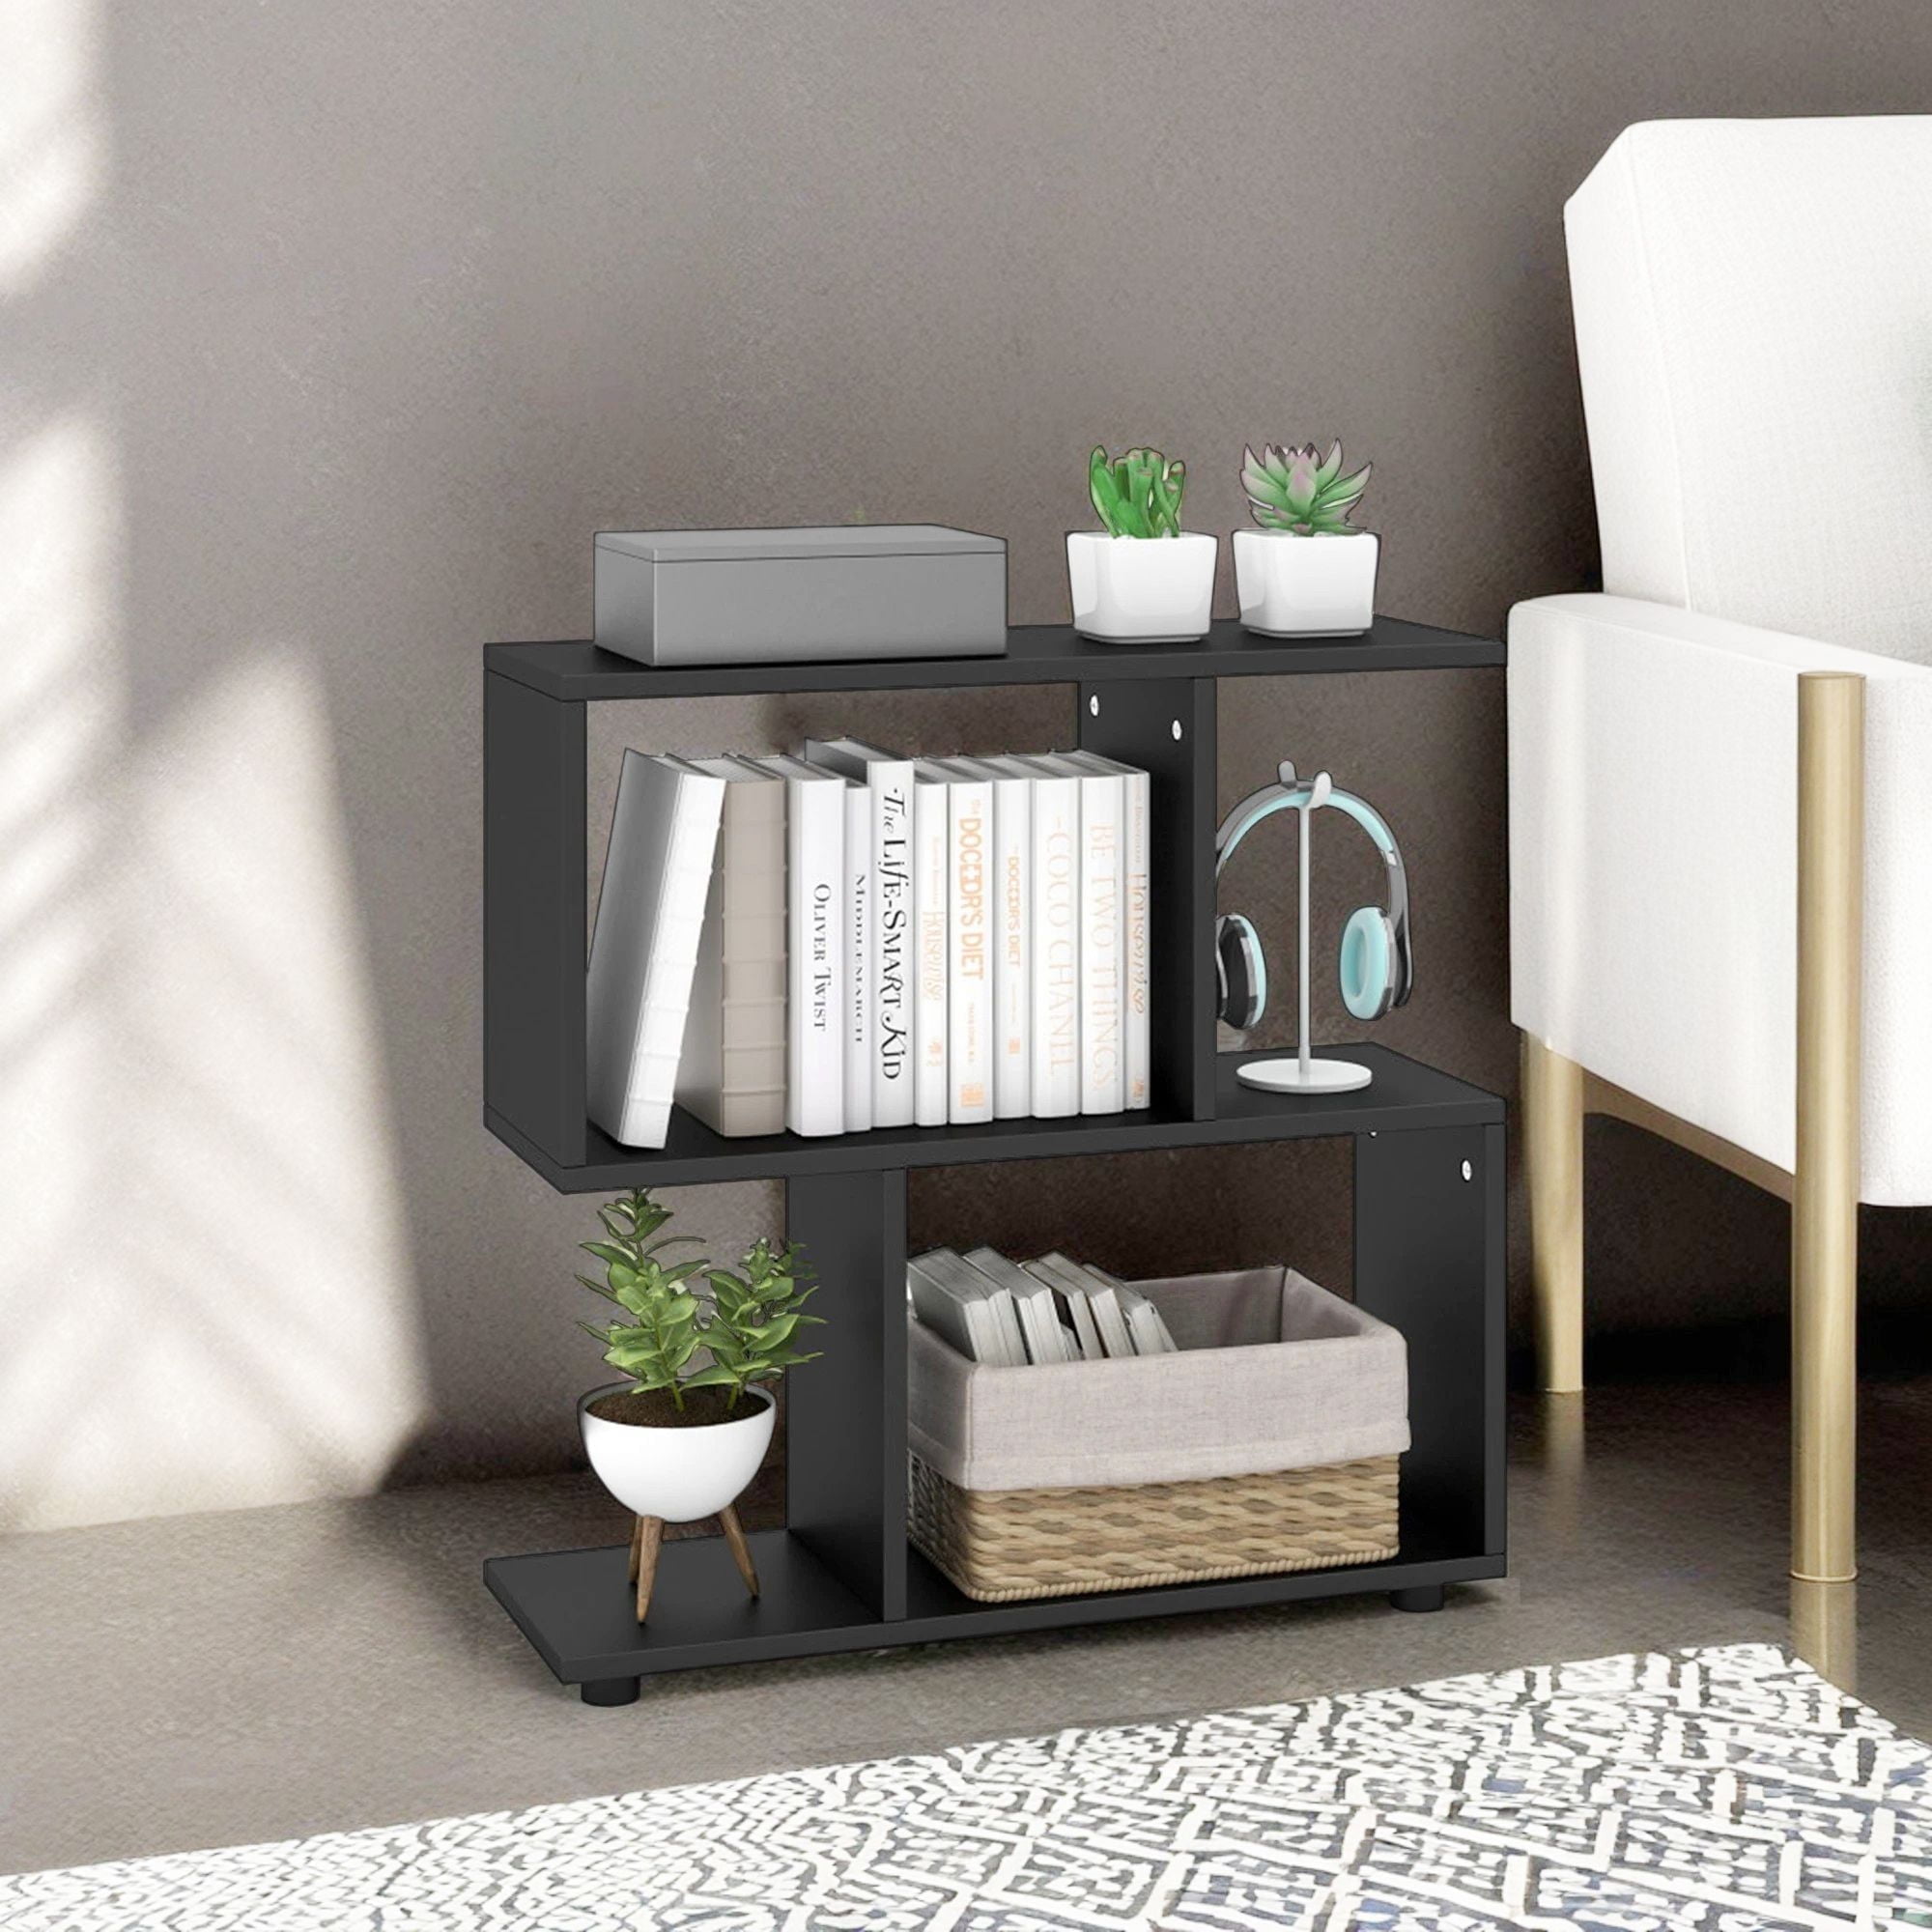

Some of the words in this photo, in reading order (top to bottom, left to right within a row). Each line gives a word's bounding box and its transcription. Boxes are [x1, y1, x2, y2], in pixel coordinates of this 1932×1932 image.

[1090, 823, 1115, 858] BE
[1091, 875, 1118, 948] TWO
[961, 932, 984, 980] DIET
[1008, 934, 1021, 967] DIET
[1049, 939, 1075, 1076] CHANEL
